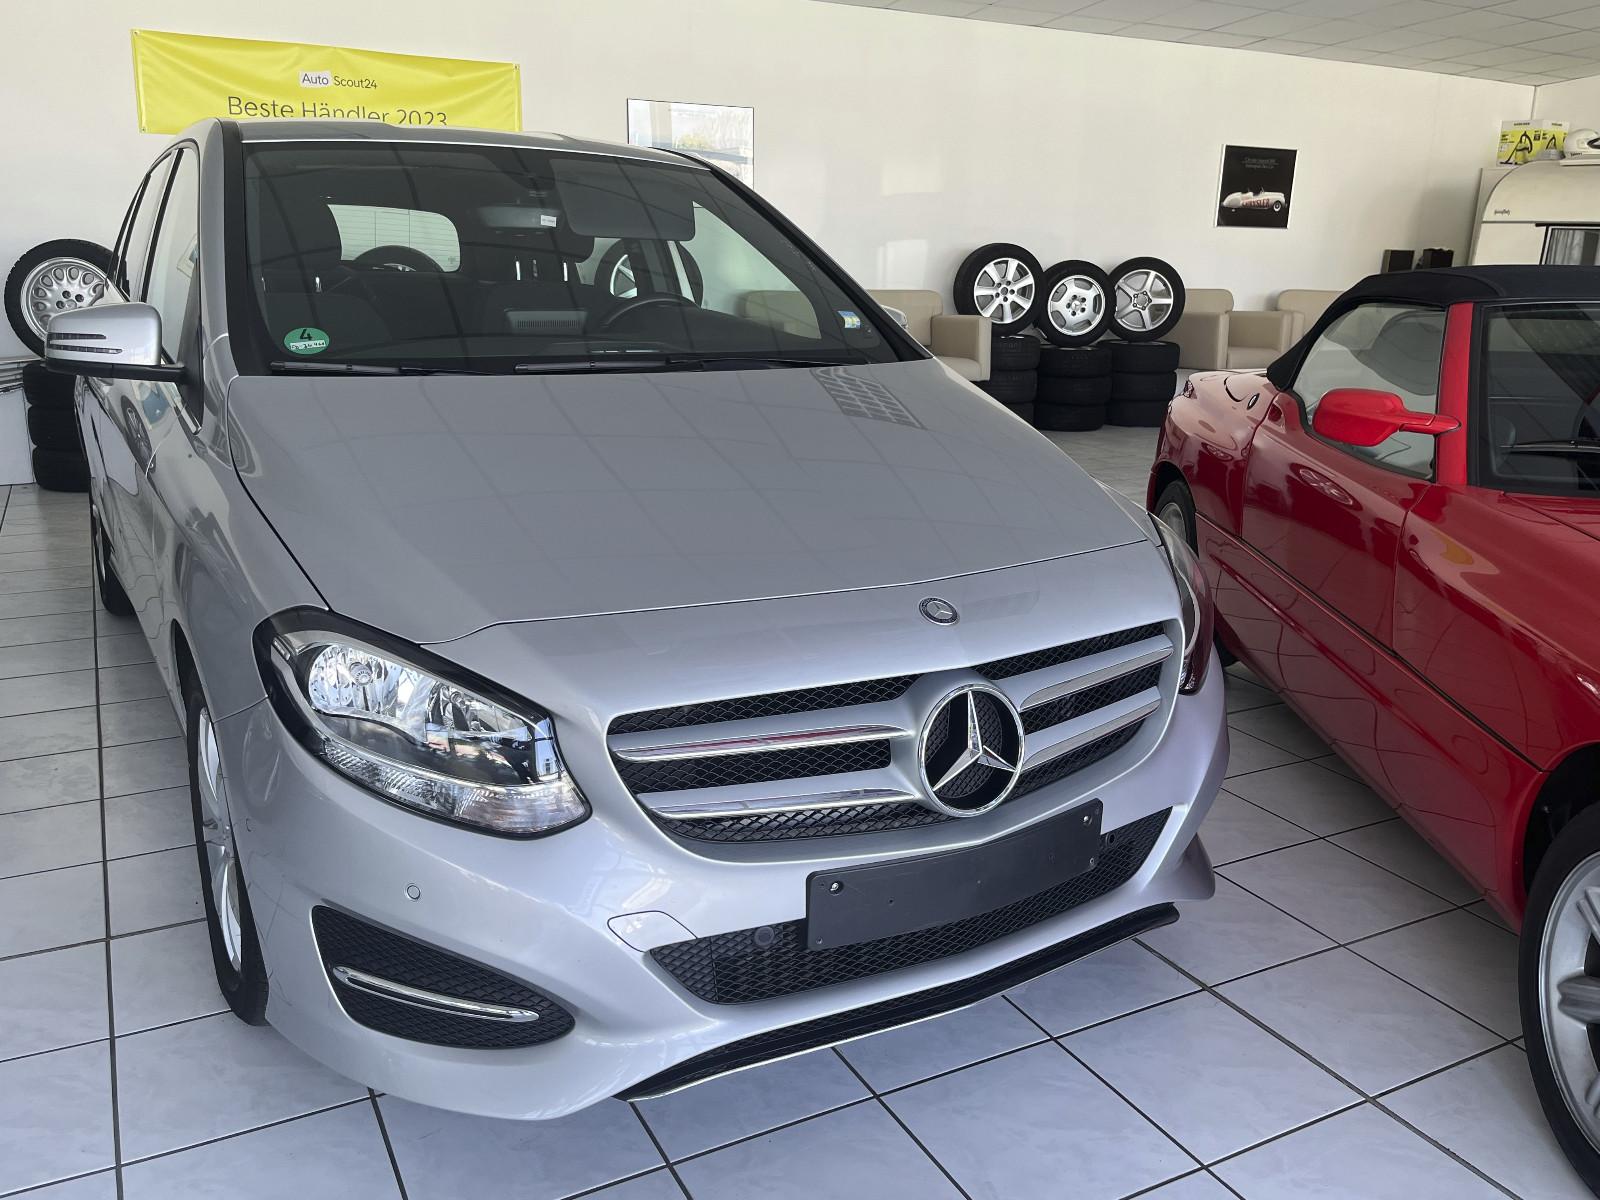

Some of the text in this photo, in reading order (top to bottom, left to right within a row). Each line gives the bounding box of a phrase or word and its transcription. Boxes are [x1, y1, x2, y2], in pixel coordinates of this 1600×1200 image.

[301, 72, 378, 90] Auto Scout24
[227, 96, 448, 126] Beste Händler 2023
[300, 329, 312, 340] 4
